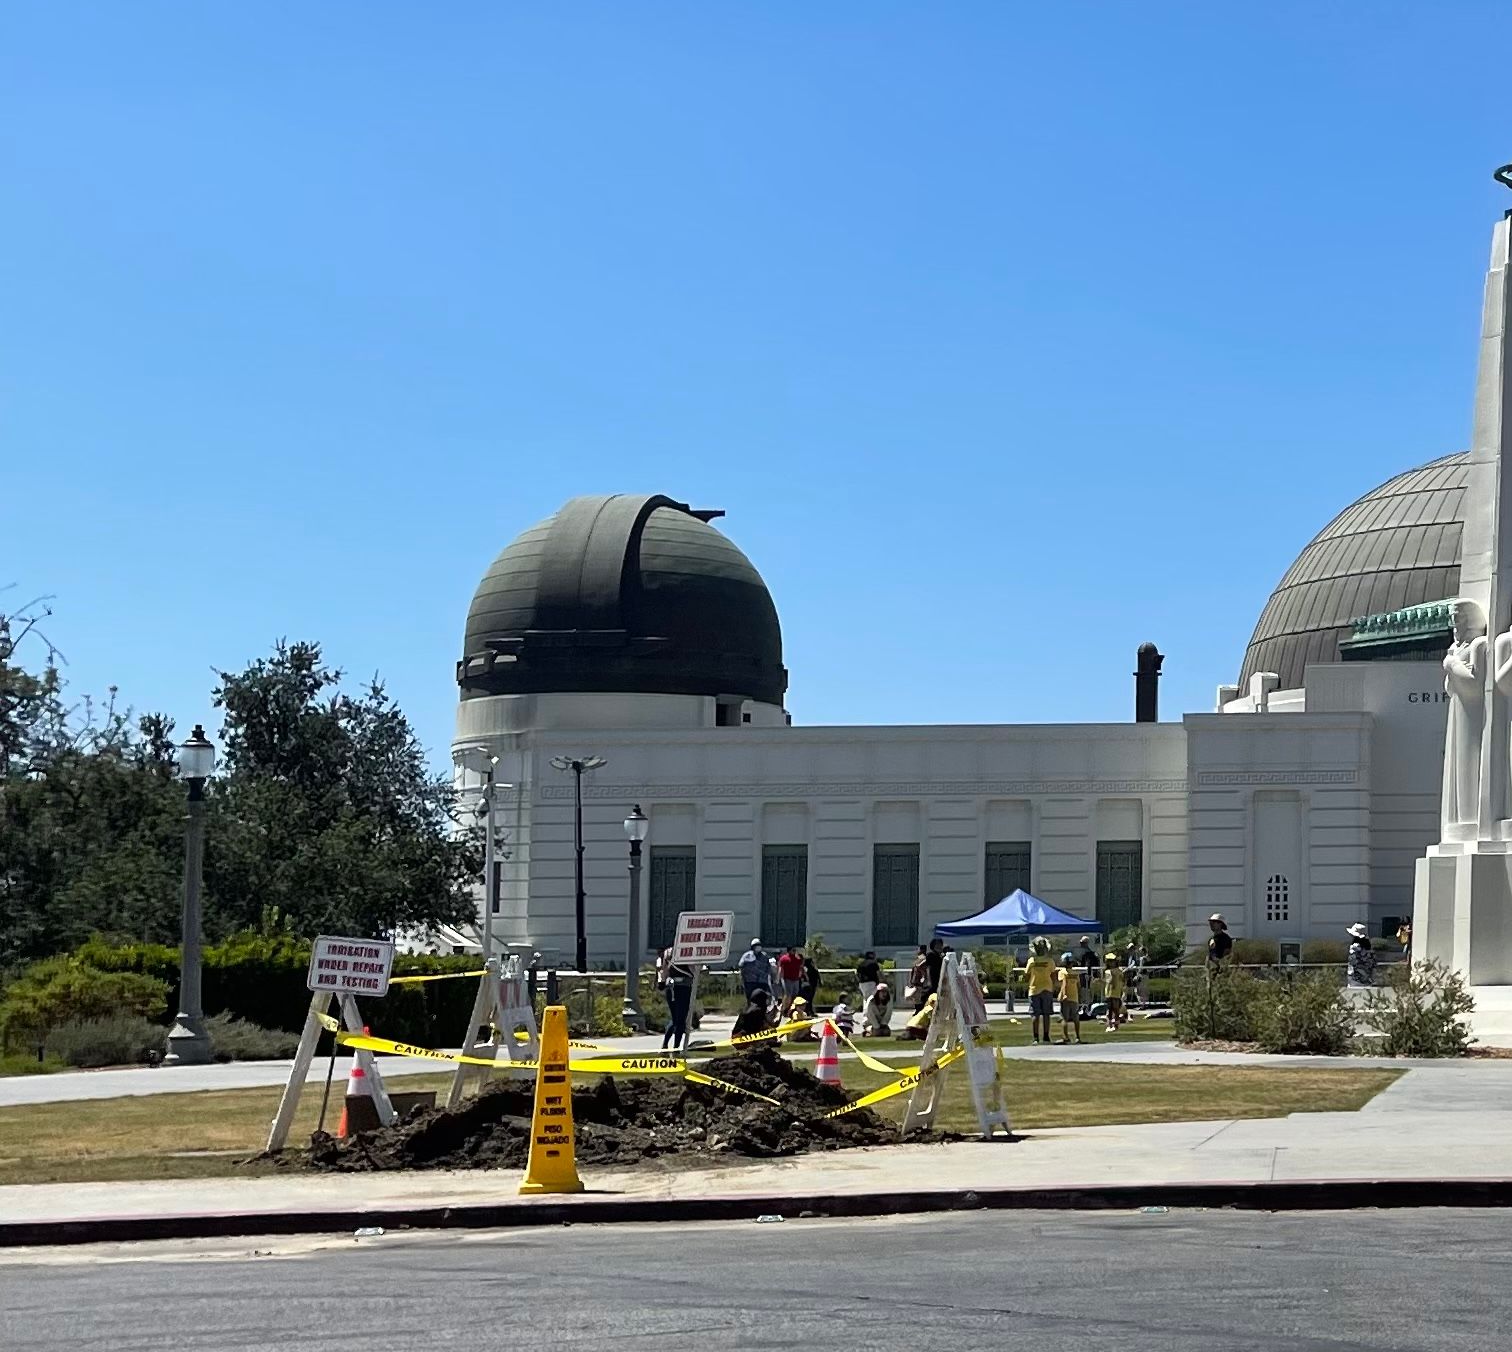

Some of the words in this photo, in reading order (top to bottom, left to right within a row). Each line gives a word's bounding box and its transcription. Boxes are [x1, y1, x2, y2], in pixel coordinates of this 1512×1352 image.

[1408, 691, 1450, 703] GRIF
[317, 958, 349, 971] UNDER
[352, 961, 385, 974] REPAIR
[317, 973, 338, 985] AND
[341, 975, 379, 990] TESTING
[393, 1044, 456, 1060] CAUTION
[621, 1059, 678, 1069] CAUTION
